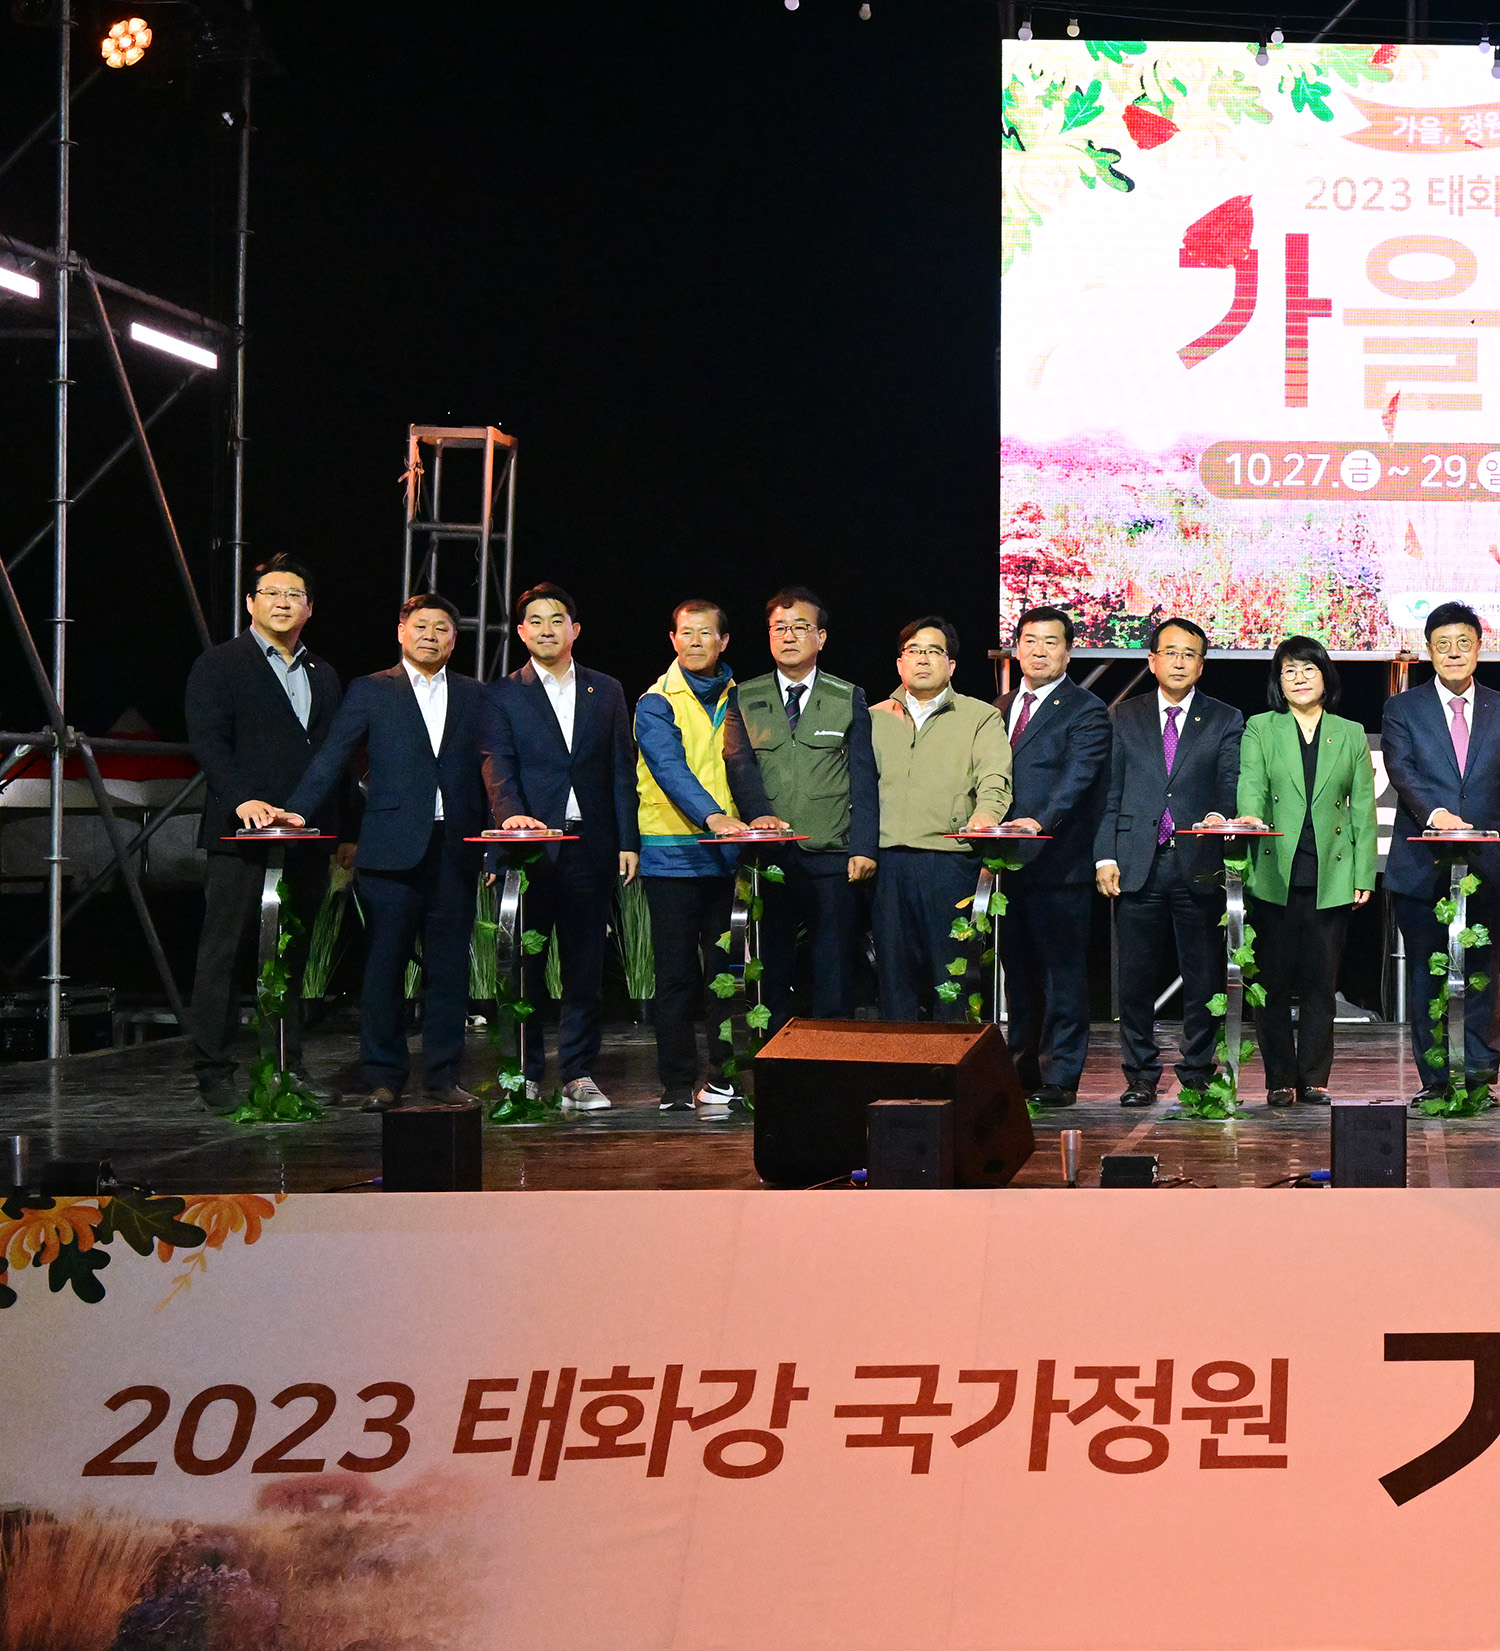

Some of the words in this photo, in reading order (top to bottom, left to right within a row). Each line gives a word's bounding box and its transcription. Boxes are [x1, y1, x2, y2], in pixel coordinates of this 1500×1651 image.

[1392, 114, 1451, 146] 가을,
[1304, 175, 1412, 212] 2023
[82, 1381, 417, 1478] 2023
[452, 1362, 809, 1482] 태화강
[834, 1357, 1290, 1473] 국가정원
